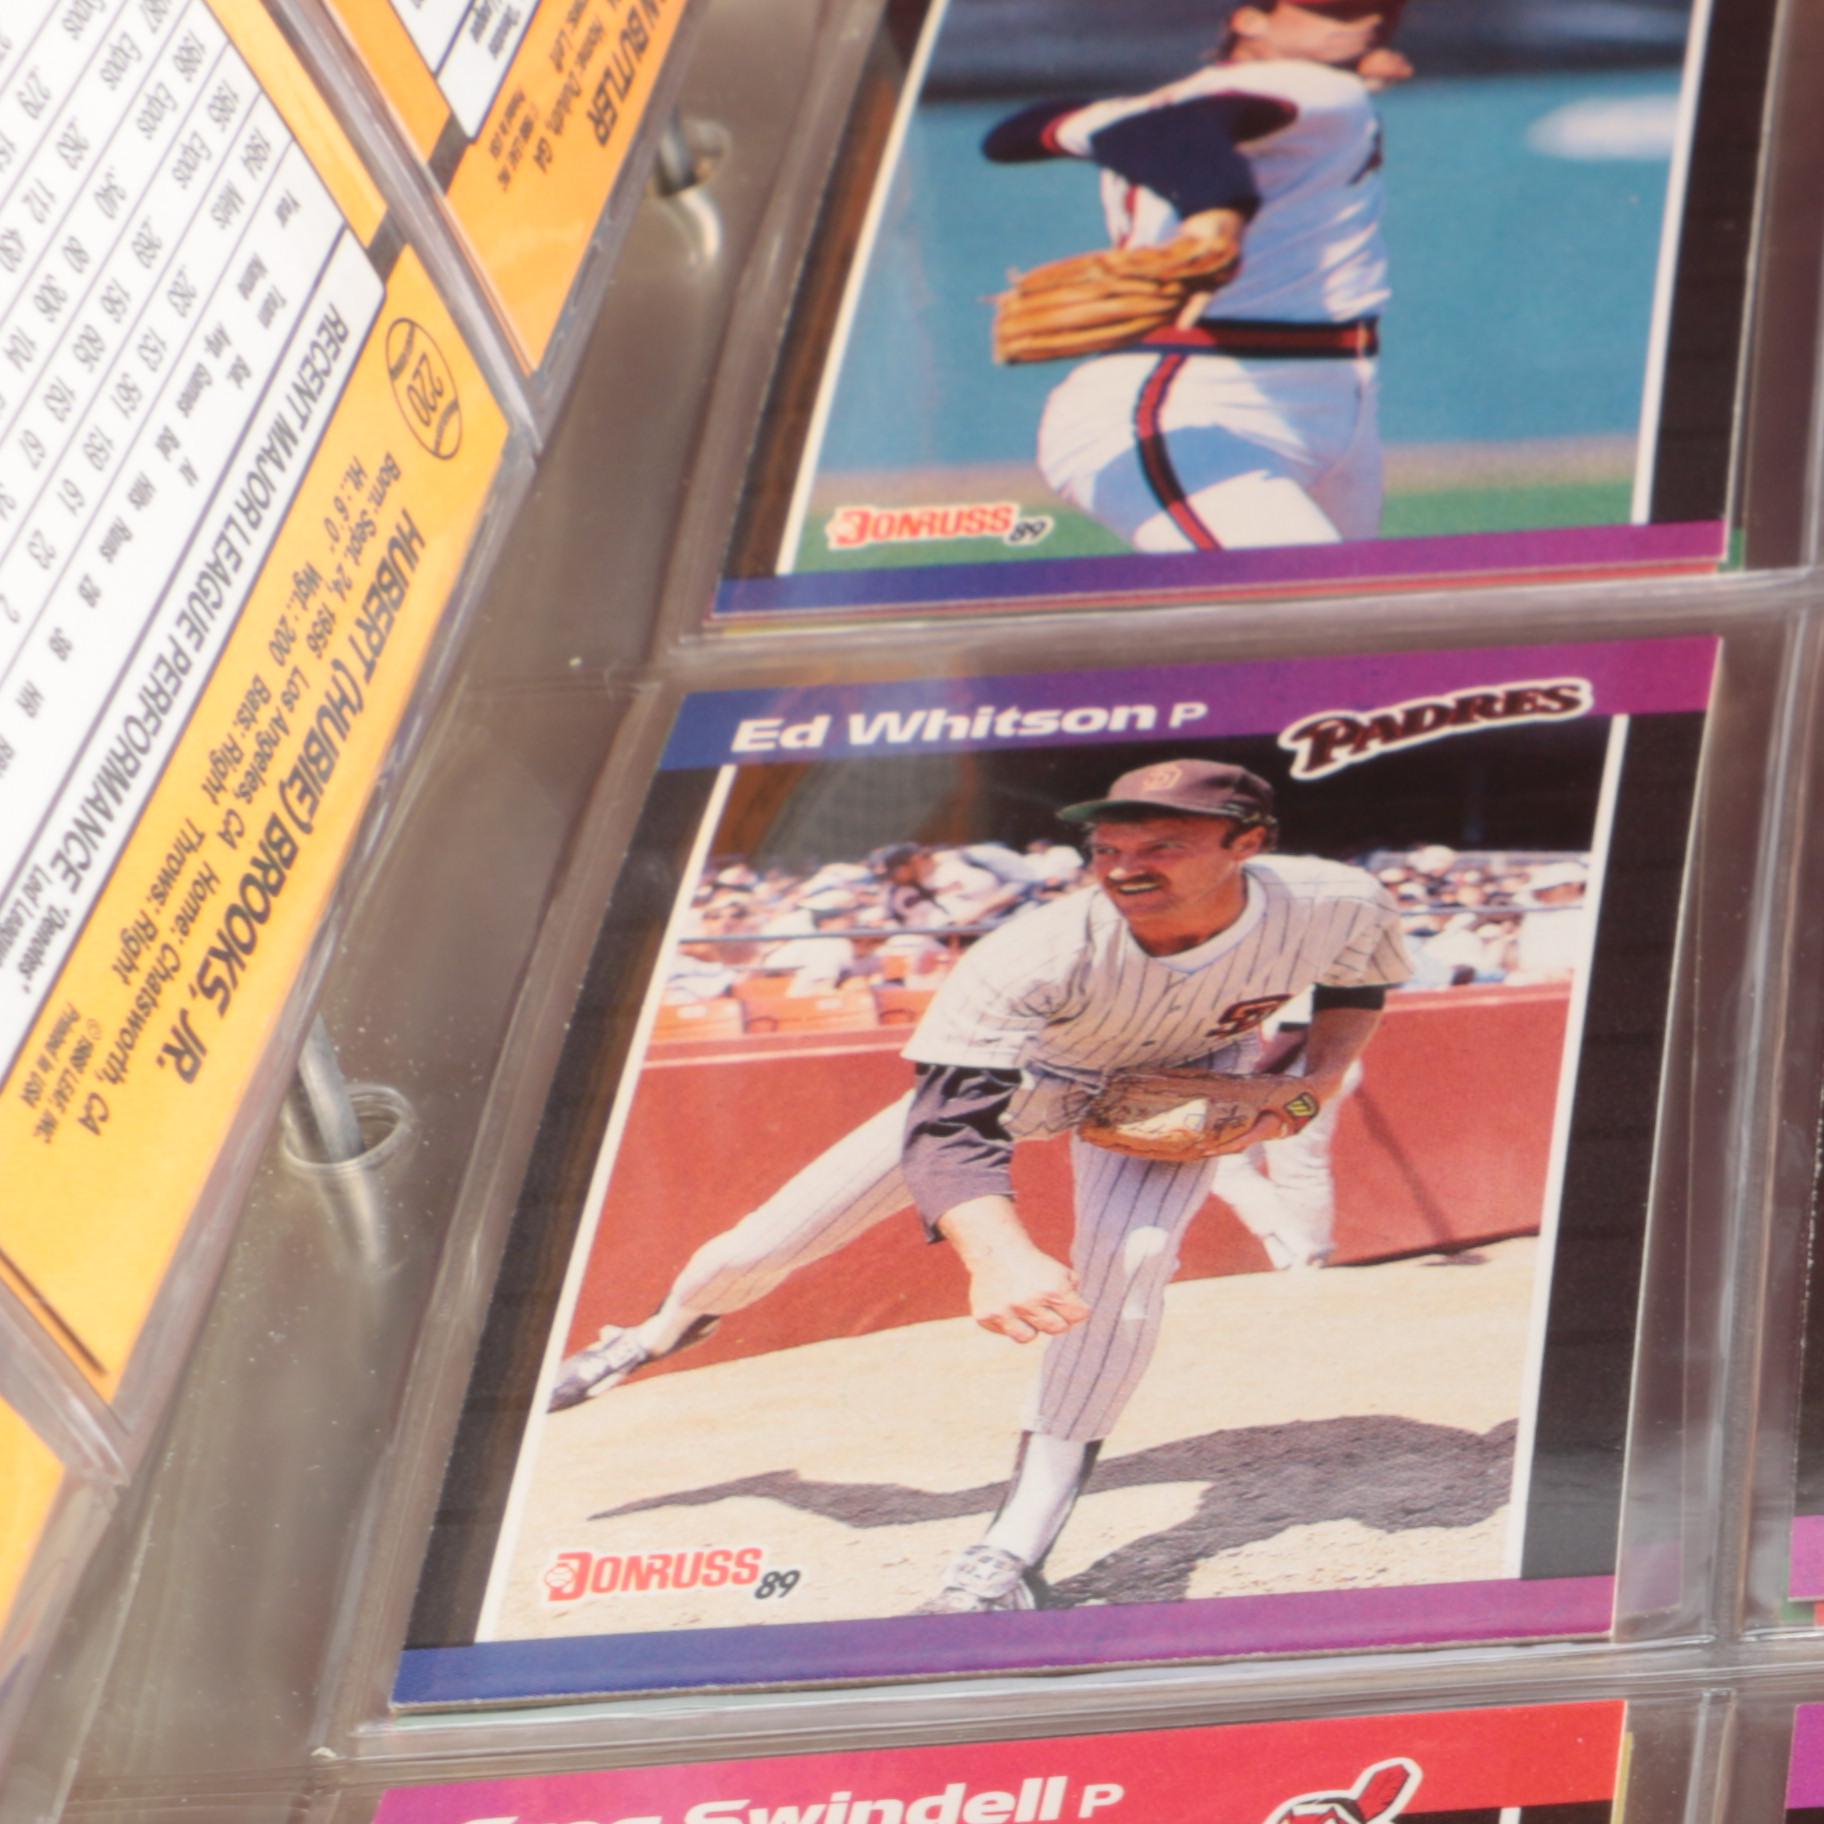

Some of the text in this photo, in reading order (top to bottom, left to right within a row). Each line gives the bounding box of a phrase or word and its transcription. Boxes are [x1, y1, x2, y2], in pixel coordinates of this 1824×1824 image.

[98, 30, 143, 91] Expos
[585, 5, 650, 148] BUTLER
[134, 80, 178, 141] Expos
[170, 129, 213, 190] Expos
[209, 179, 245, 230] Mets
[273, 189, 301, 228] Year
[405, 351, 445, 428] 220
[17, 428, 46, 471] 67
[56, 477, 85, 516] 61
[366, 450, 402, 513] Born:
[97, 515, 133, 564] Runs
[342, 507, 377, 566] Sept.
[836, 503, 1014, 545] DONRUSS
[48, 302, 349, 895] RECENT MAJOR LEAGUE PERFORMANCE
[325, 562, 353, 603] 24,
[267, 613, 297, 668] 200
[231, 673, 272, 738] Bats:
[279, 664, 310, 714] Los
[231, 706, 290, 805] Angeles,
[730, 701, 1208, 753] Ed Whitson P
[1289, 683, 1584, 773] PADRES
[154, 507, 426, 1084] HUBERT (HUBIE) BROOKS, JR.
[199, 732, 245, 806] Right
[215, 807, 245, 850] CA
[144, 817, 206, 914] Throws:
[169, 860, 220, 945] Home:
[110, 909, 159, 986] Right
[95, 941, 181, 1085] Chatsworth,
[76, 1090, 110, 1136] CA
[545, 1547, 800, 1601] DONRUSS 89
[1078, 1783, 1124, 1819] P
